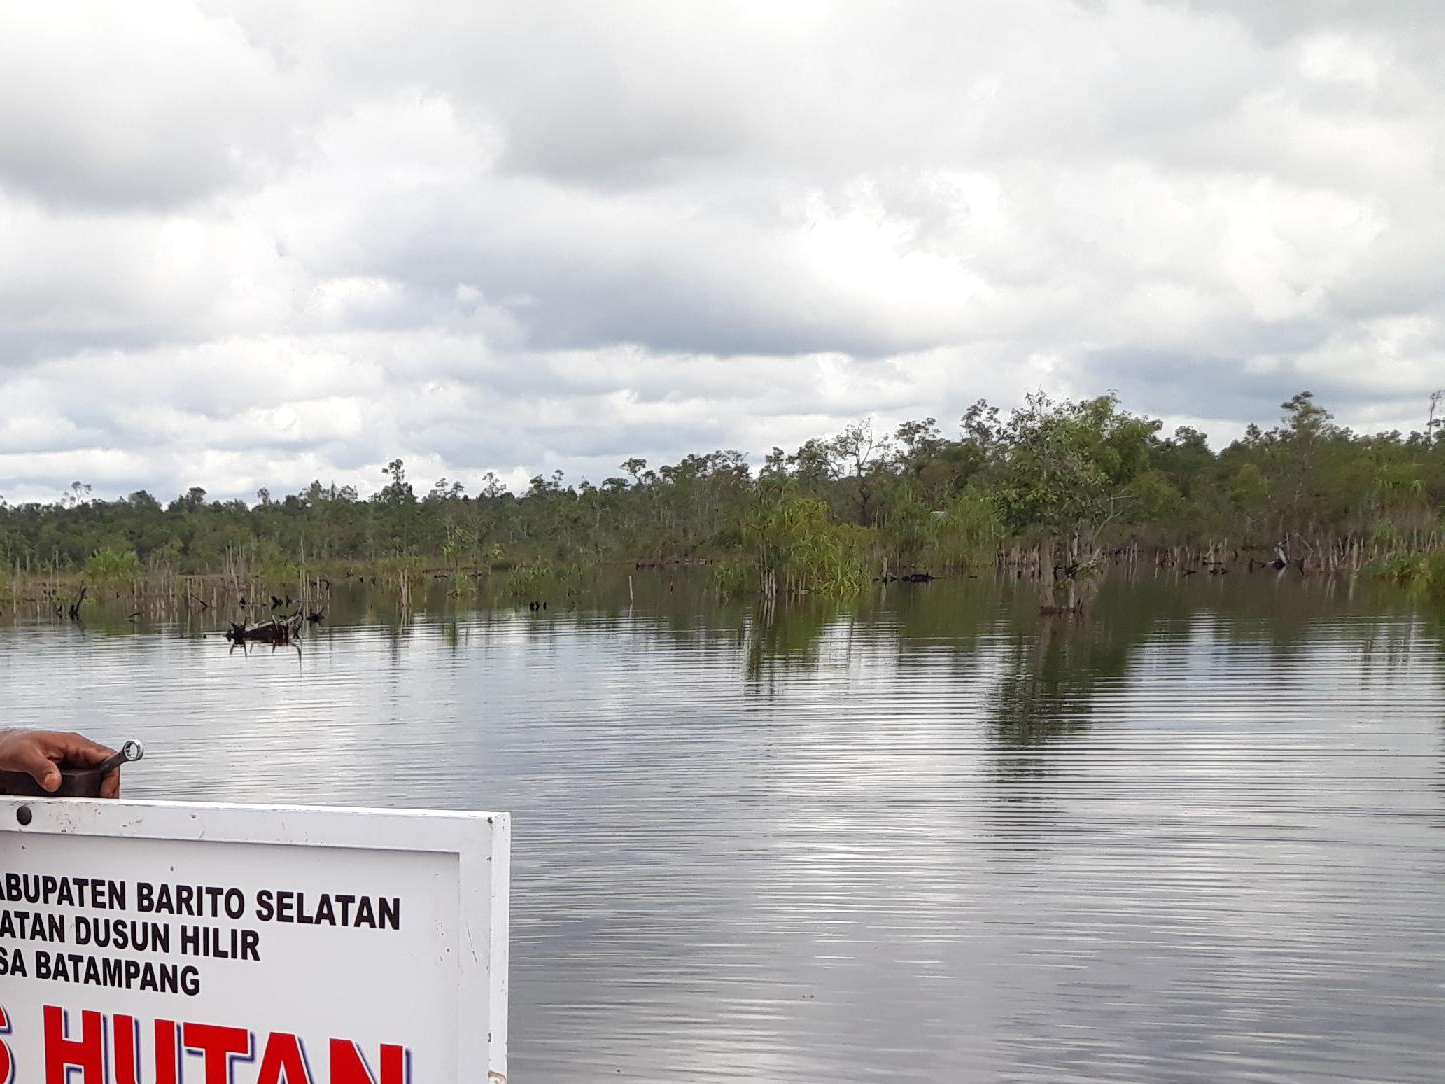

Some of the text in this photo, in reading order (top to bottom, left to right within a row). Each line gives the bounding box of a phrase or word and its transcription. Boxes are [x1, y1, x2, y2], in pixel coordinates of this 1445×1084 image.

[136, 882, 245, 920] BARITO
[255, 889, 401, 931] SELATAN
[74, 915, 170, 954] DUSUN
[180, 924, 261, 962] HILIR
[35, 950, 200, 997] BATAMPANG
